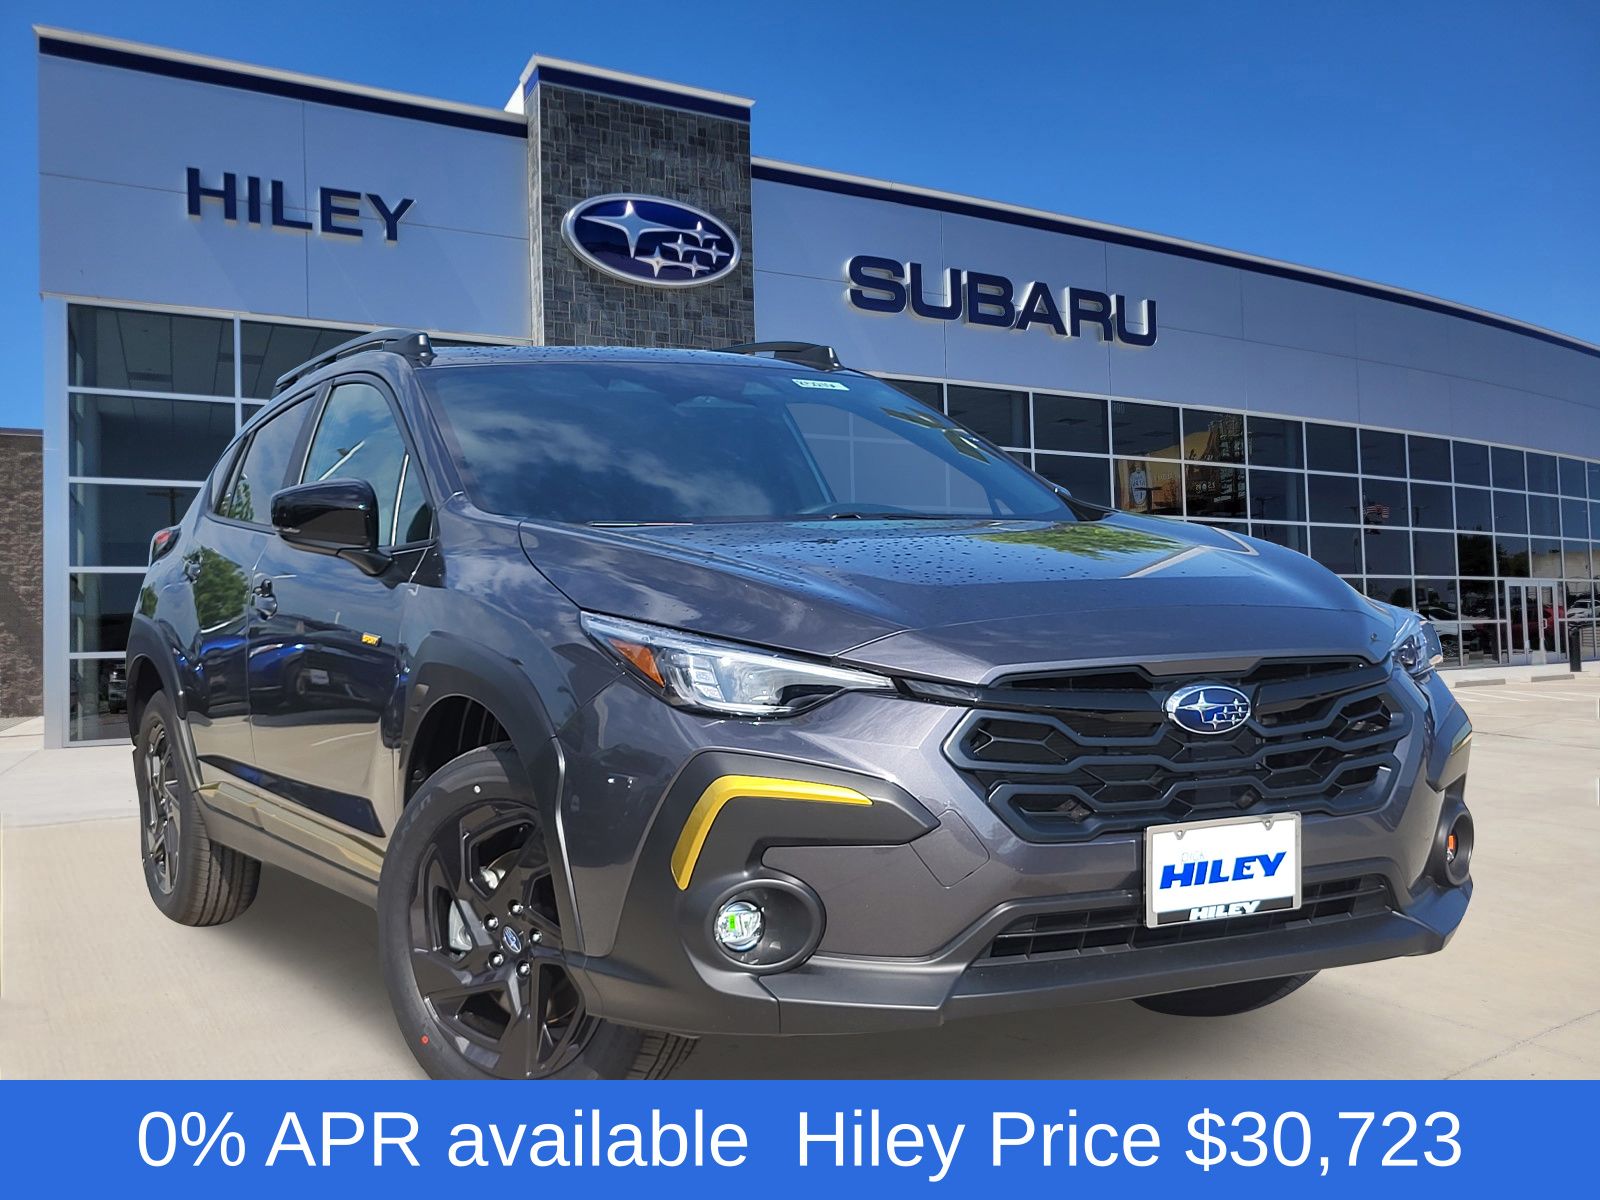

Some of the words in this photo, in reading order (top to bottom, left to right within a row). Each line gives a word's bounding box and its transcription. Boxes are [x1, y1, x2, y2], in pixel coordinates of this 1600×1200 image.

[185, 166, 415, 242] HILEY
[846, 254, 1158, 347] SUBARU
[1159, 851, 1287, 890] HILEY
[1189, 900, 1261, 922] HILEY
